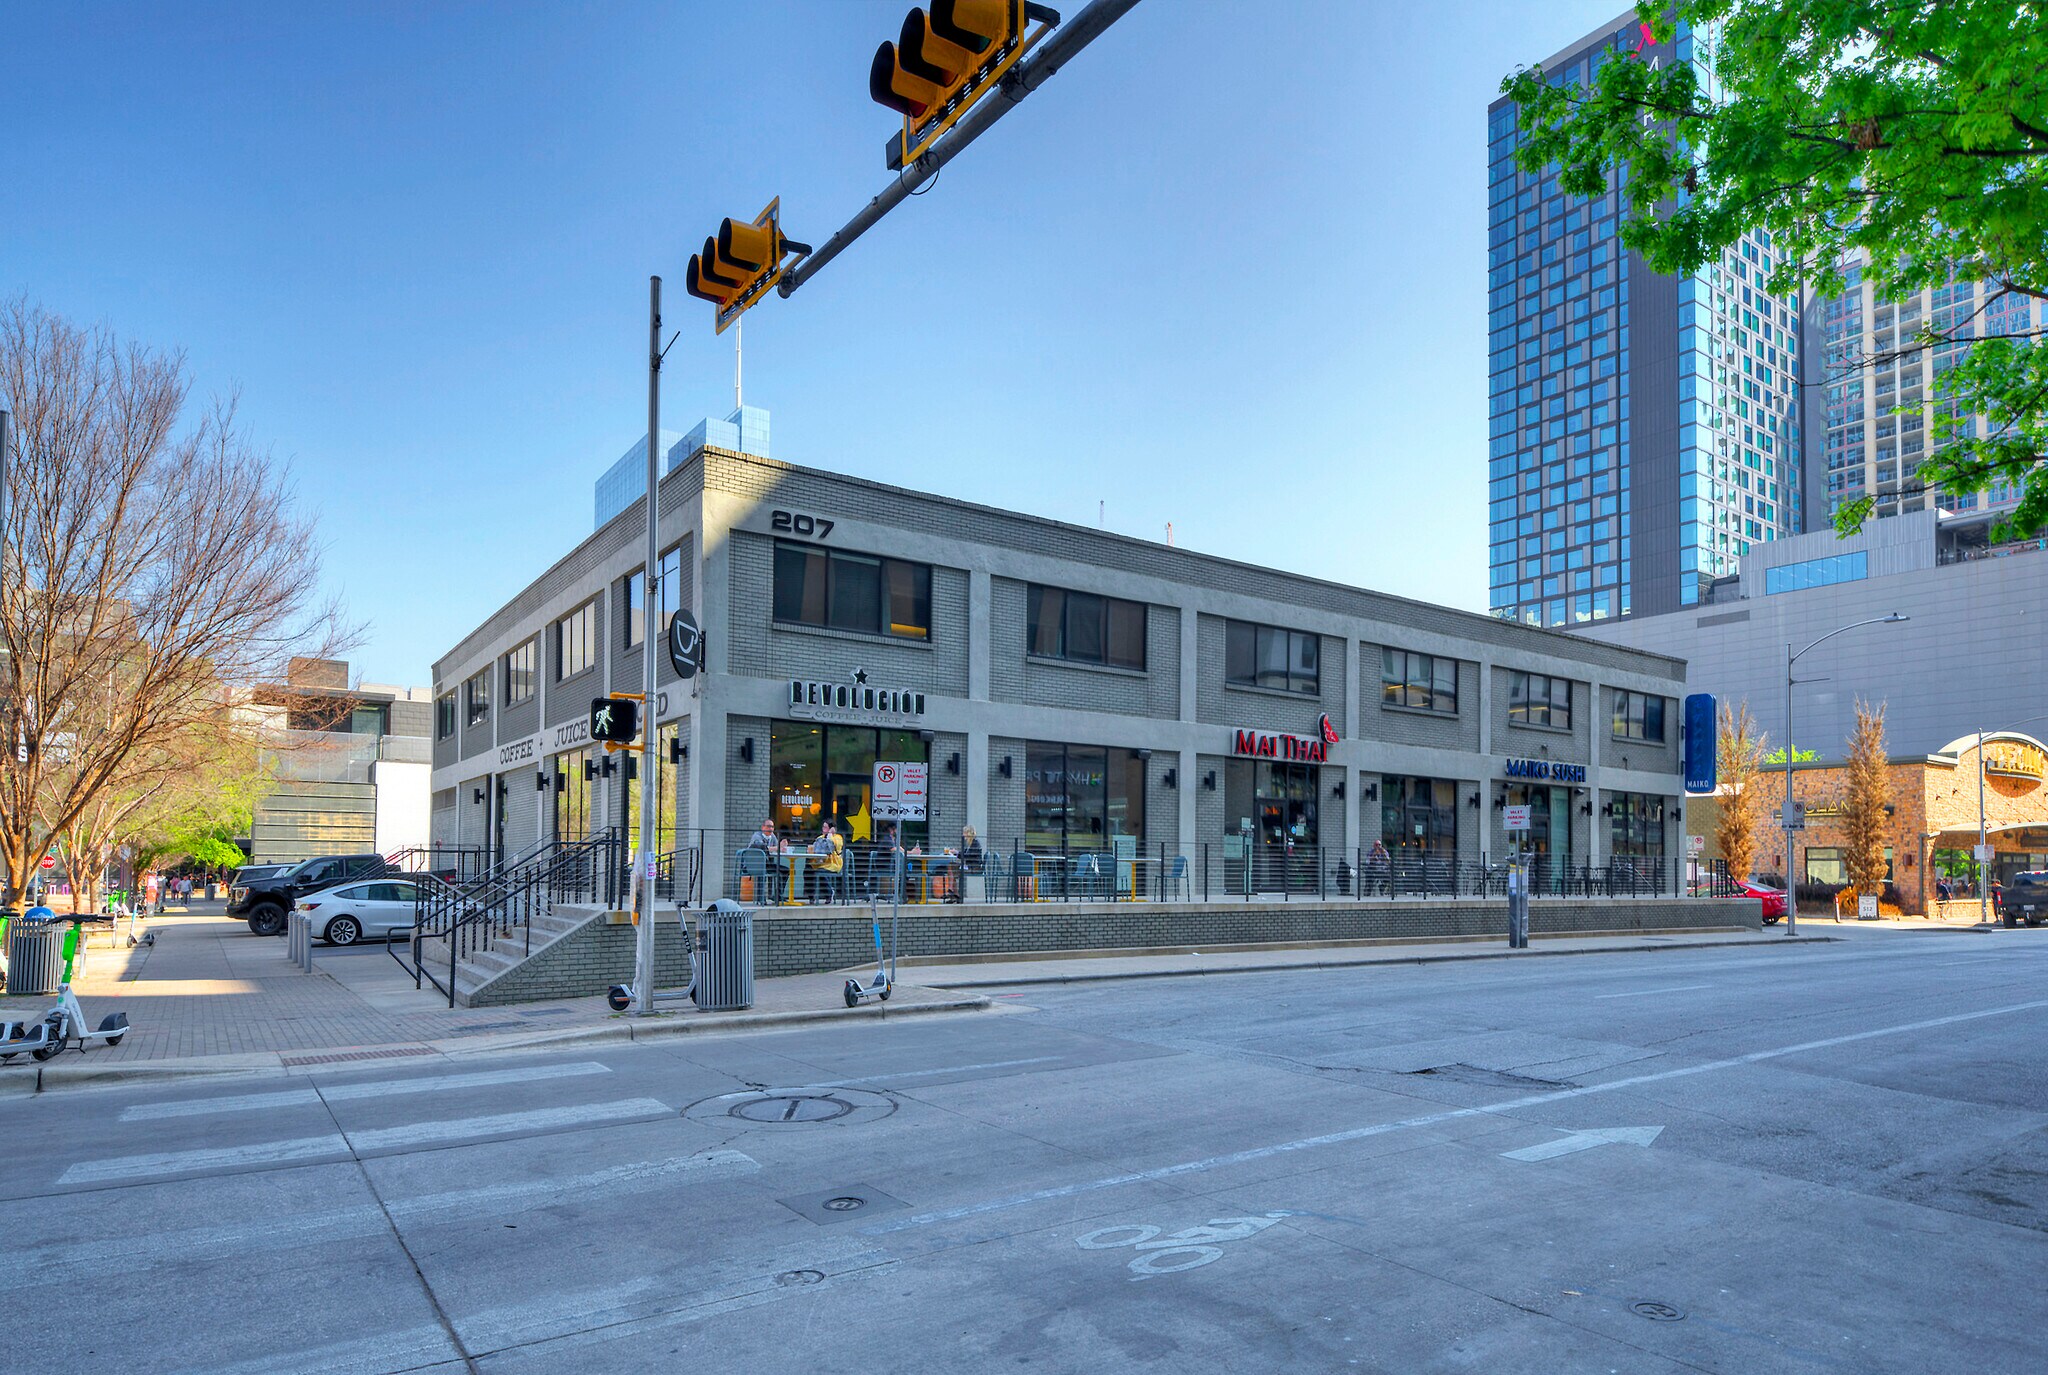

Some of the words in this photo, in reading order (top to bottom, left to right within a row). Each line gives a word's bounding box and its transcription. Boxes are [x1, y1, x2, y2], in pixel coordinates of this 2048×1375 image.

[771, 510, 834, 538] 207
[791, 681, 925, 715] REVOLUCIÓN
[815, 711, 861, 721] COFFEE
[869, 715, 902, 724] JUICE
[500, 739, 534, 765] COFFEE
[554, 719, 588, 748] JUICE
[1505, 758, 1550, 779] MAIKO
[1553, 763, 1587, 782] SUSHI
[1687, 780, 1709, 788] MAIKO
